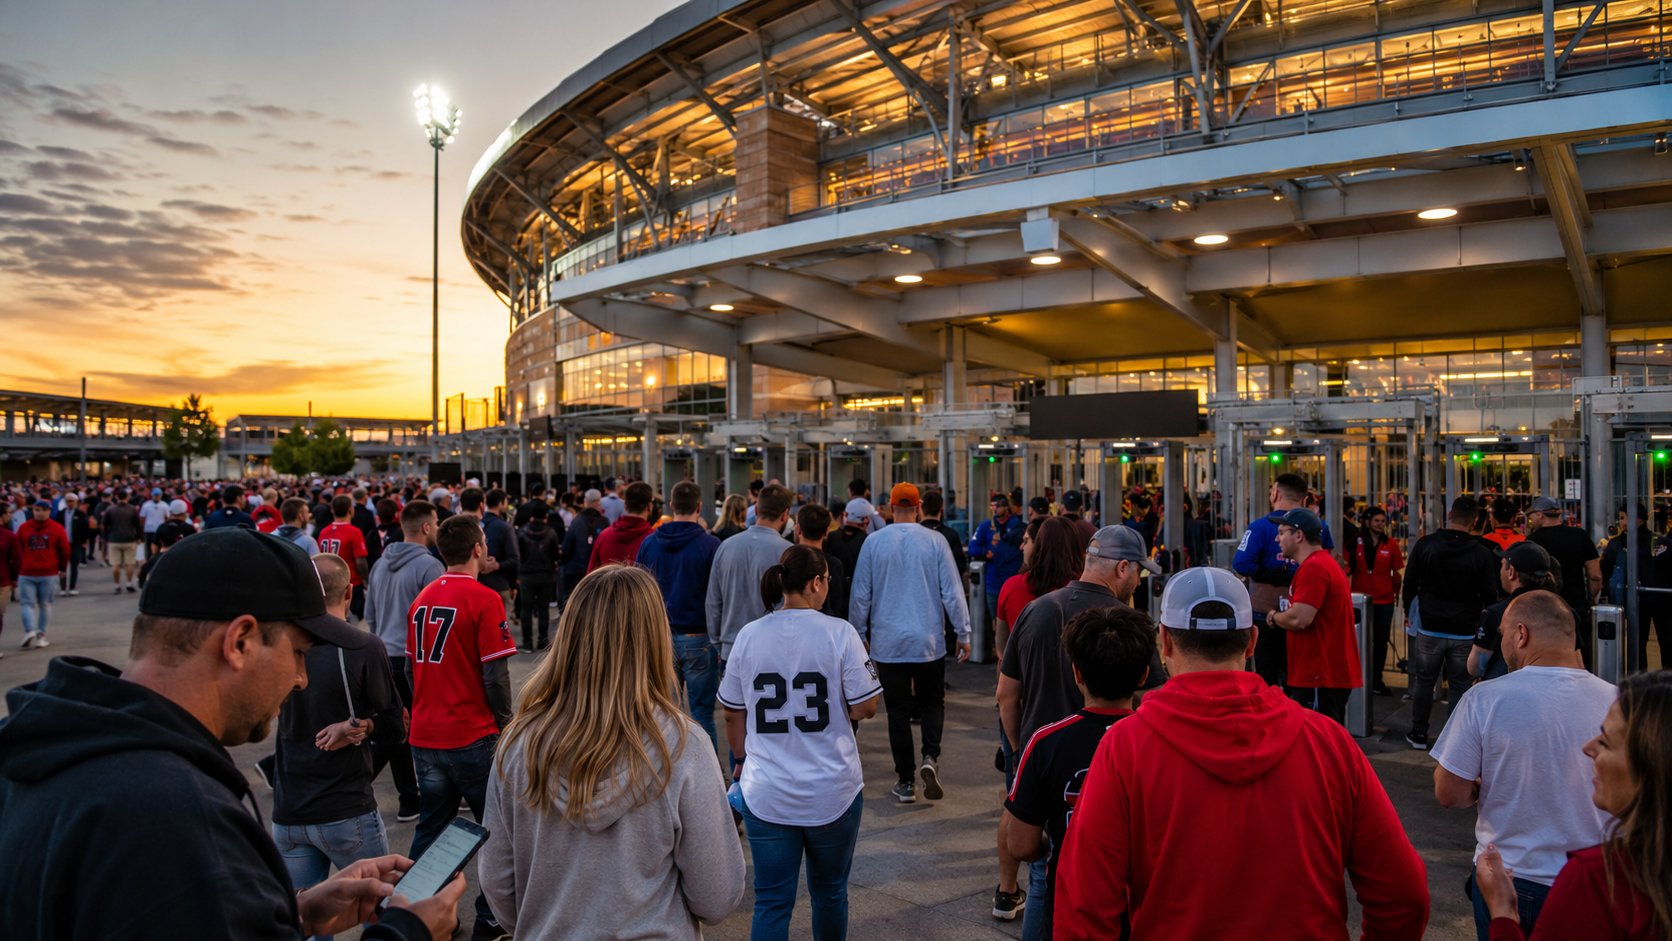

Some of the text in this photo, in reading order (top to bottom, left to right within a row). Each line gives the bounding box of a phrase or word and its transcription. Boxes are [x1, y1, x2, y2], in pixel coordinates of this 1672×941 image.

[320, 538, 341, 555] 17
[412, 605, 457, 664] 17
[753, 671, 830, 734] 23
